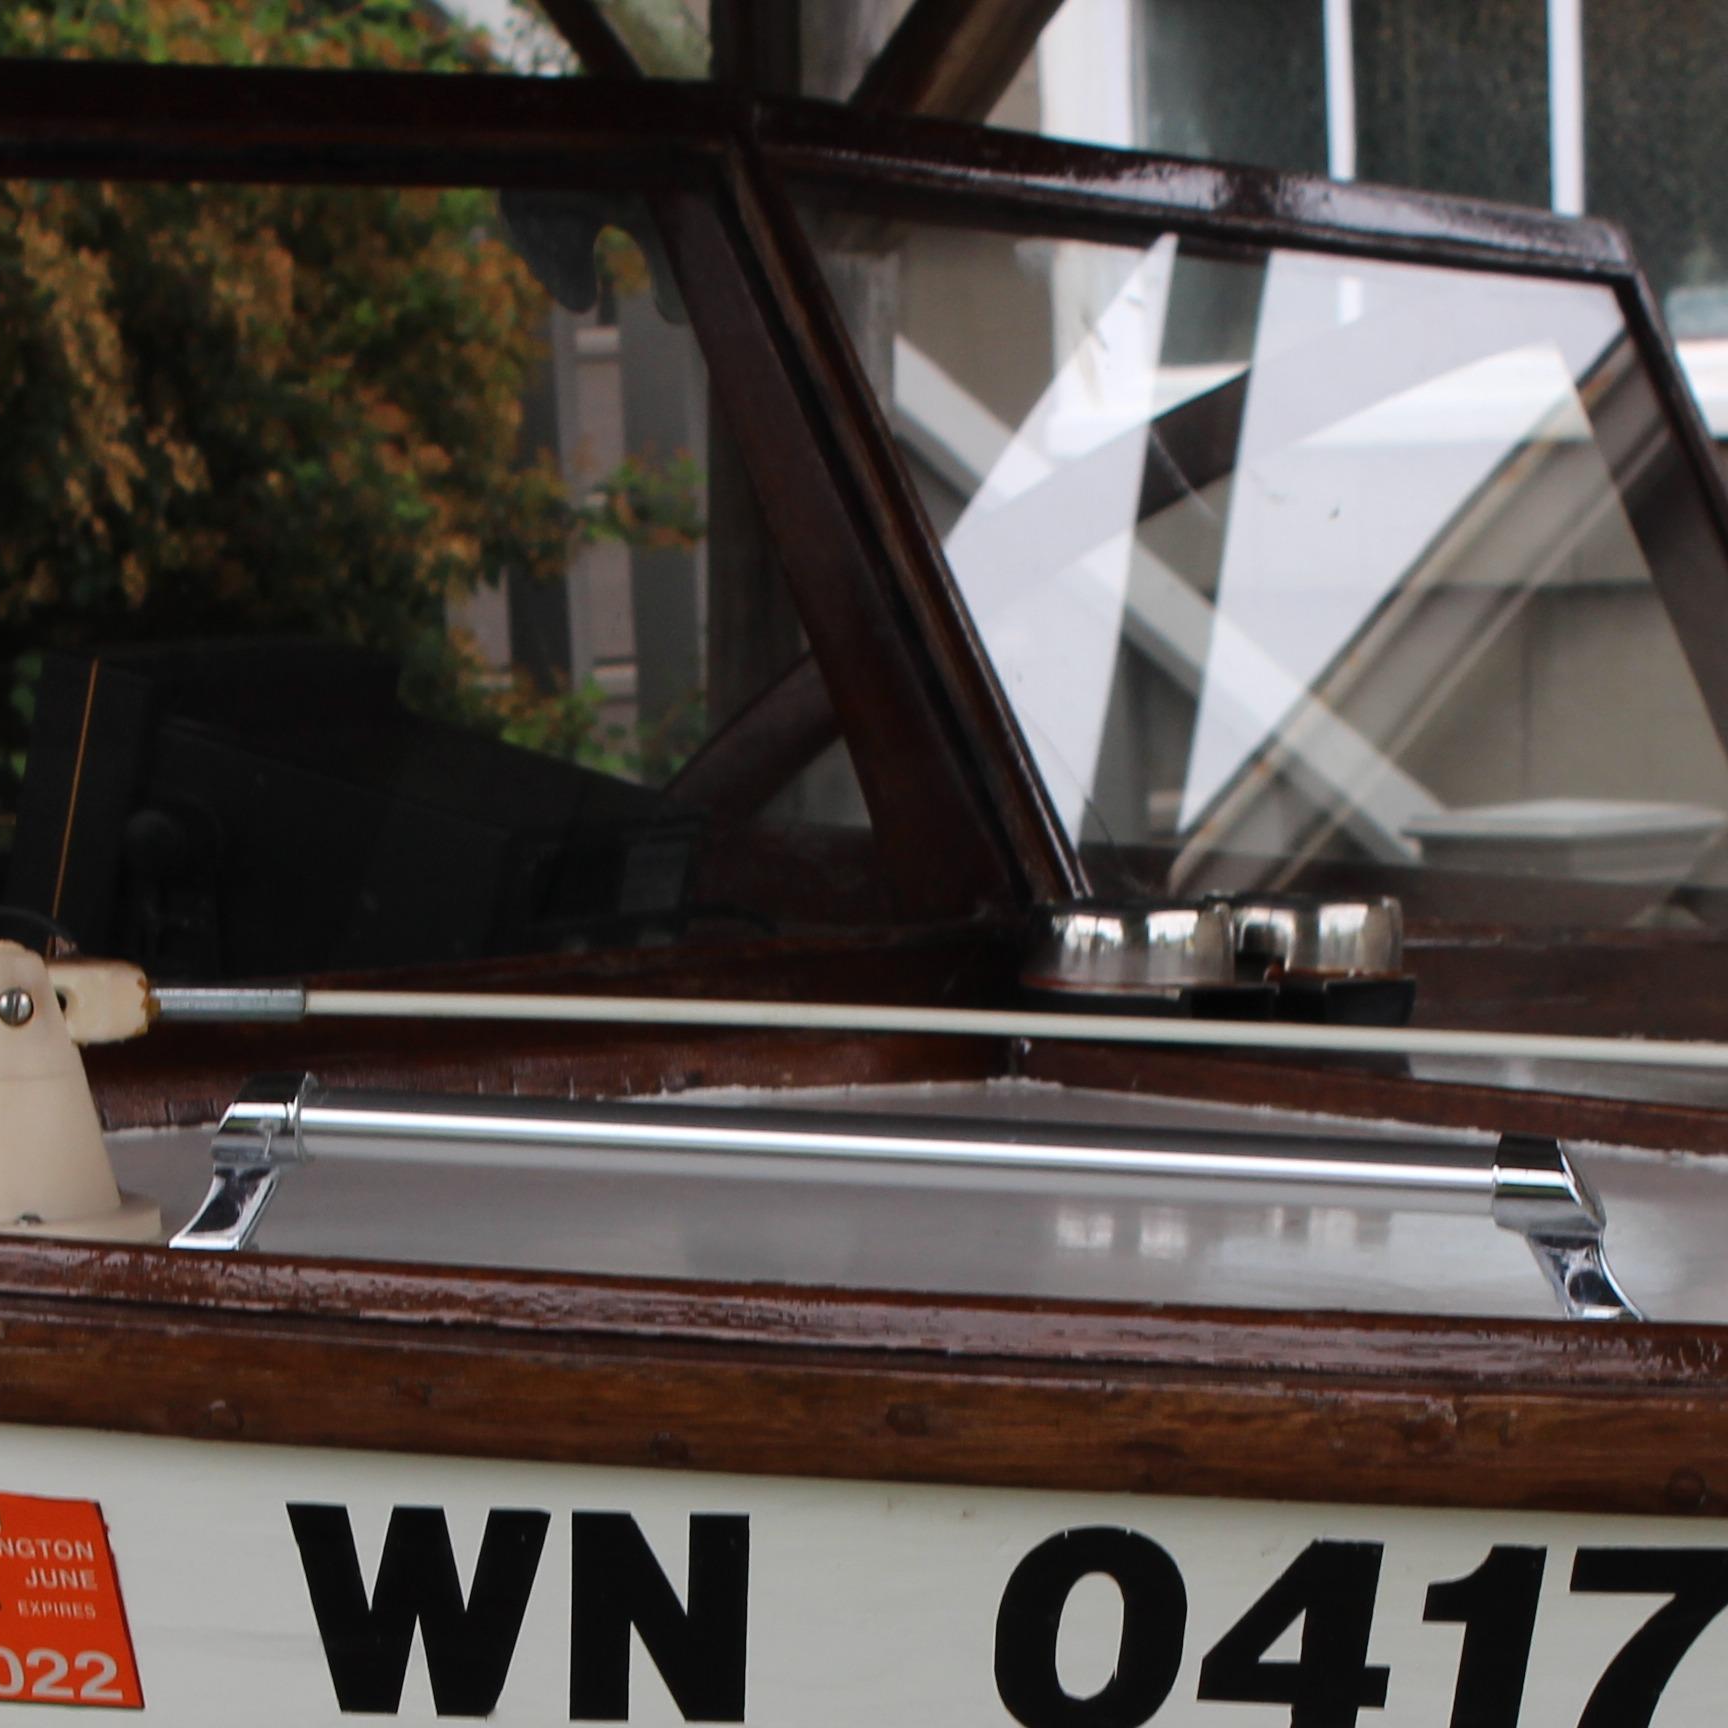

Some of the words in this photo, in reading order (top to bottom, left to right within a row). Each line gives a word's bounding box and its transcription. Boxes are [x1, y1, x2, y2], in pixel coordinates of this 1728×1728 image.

[25, 1567, 99, 1591] JUNE
[16, 1599, 98, 1620] EXPIRES
[287, 1504, 749, 1722] WN
